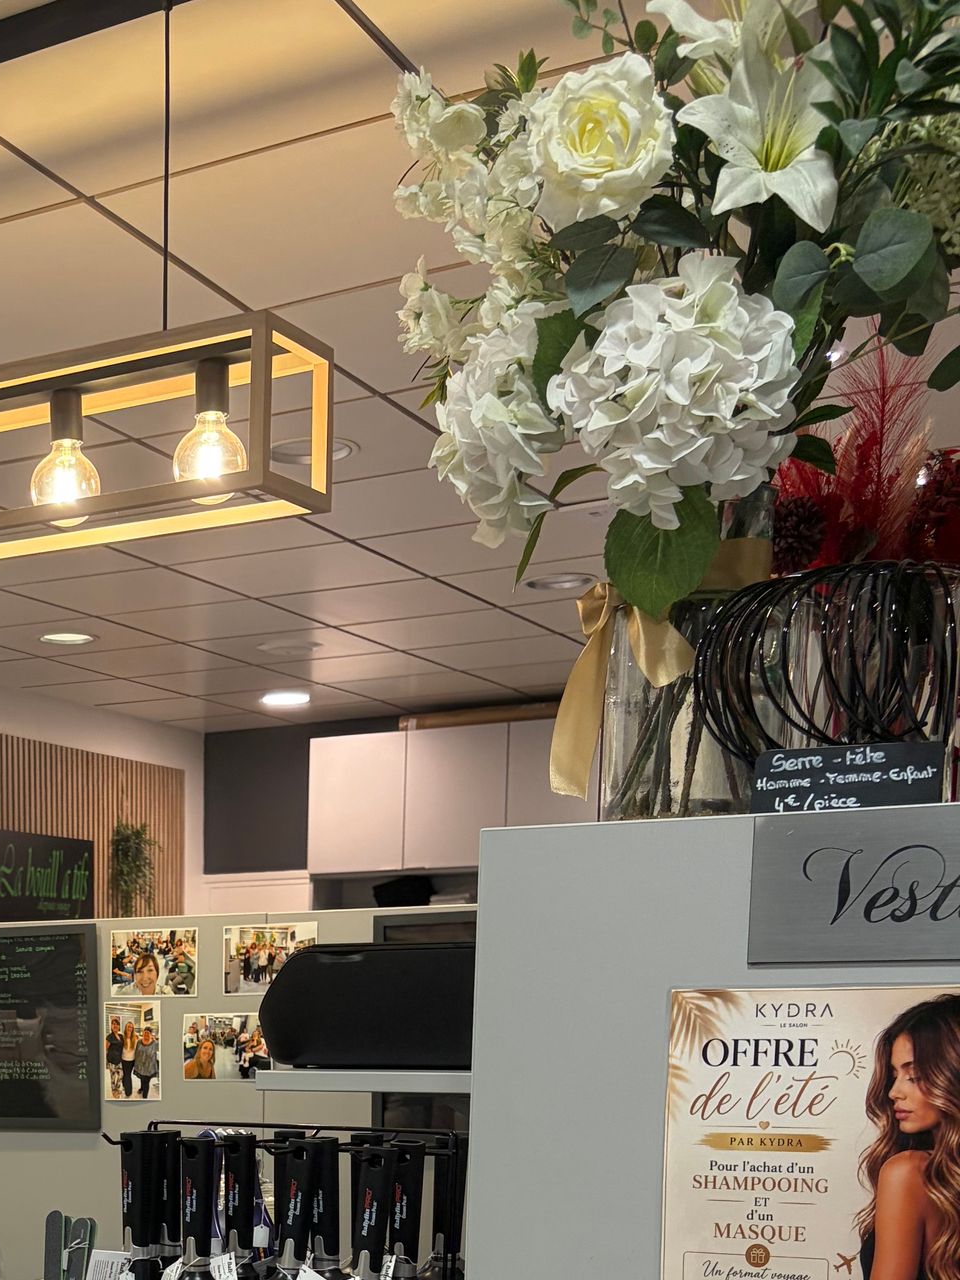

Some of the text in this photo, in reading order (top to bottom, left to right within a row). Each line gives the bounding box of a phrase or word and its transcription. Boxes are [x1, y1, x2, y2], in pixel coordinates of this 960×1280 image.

[770, 754, 823, 772] Serre
[756, 777, 811, 791] Homme
[802, 844, 960, 926] Vest
[755, 1003, 833, 1018] KYDRA
[701, 1038, 819, 1067] OFFRE
[690, 1071, 838, 1121] de l'été
[730, 1137, 803, 1147] PAR KYDRA
[709, 1160, 814, 1174] Pour l'achat d'un
[692, 1174, 829, 1193] SHAMPOOING
[754, 1197, 770, 1207] ET
[746, 1210, 774, 1221] d'un
[713, 1222, 806, 1244] MASQUE
[702, 1260, 725, 1278] Un
